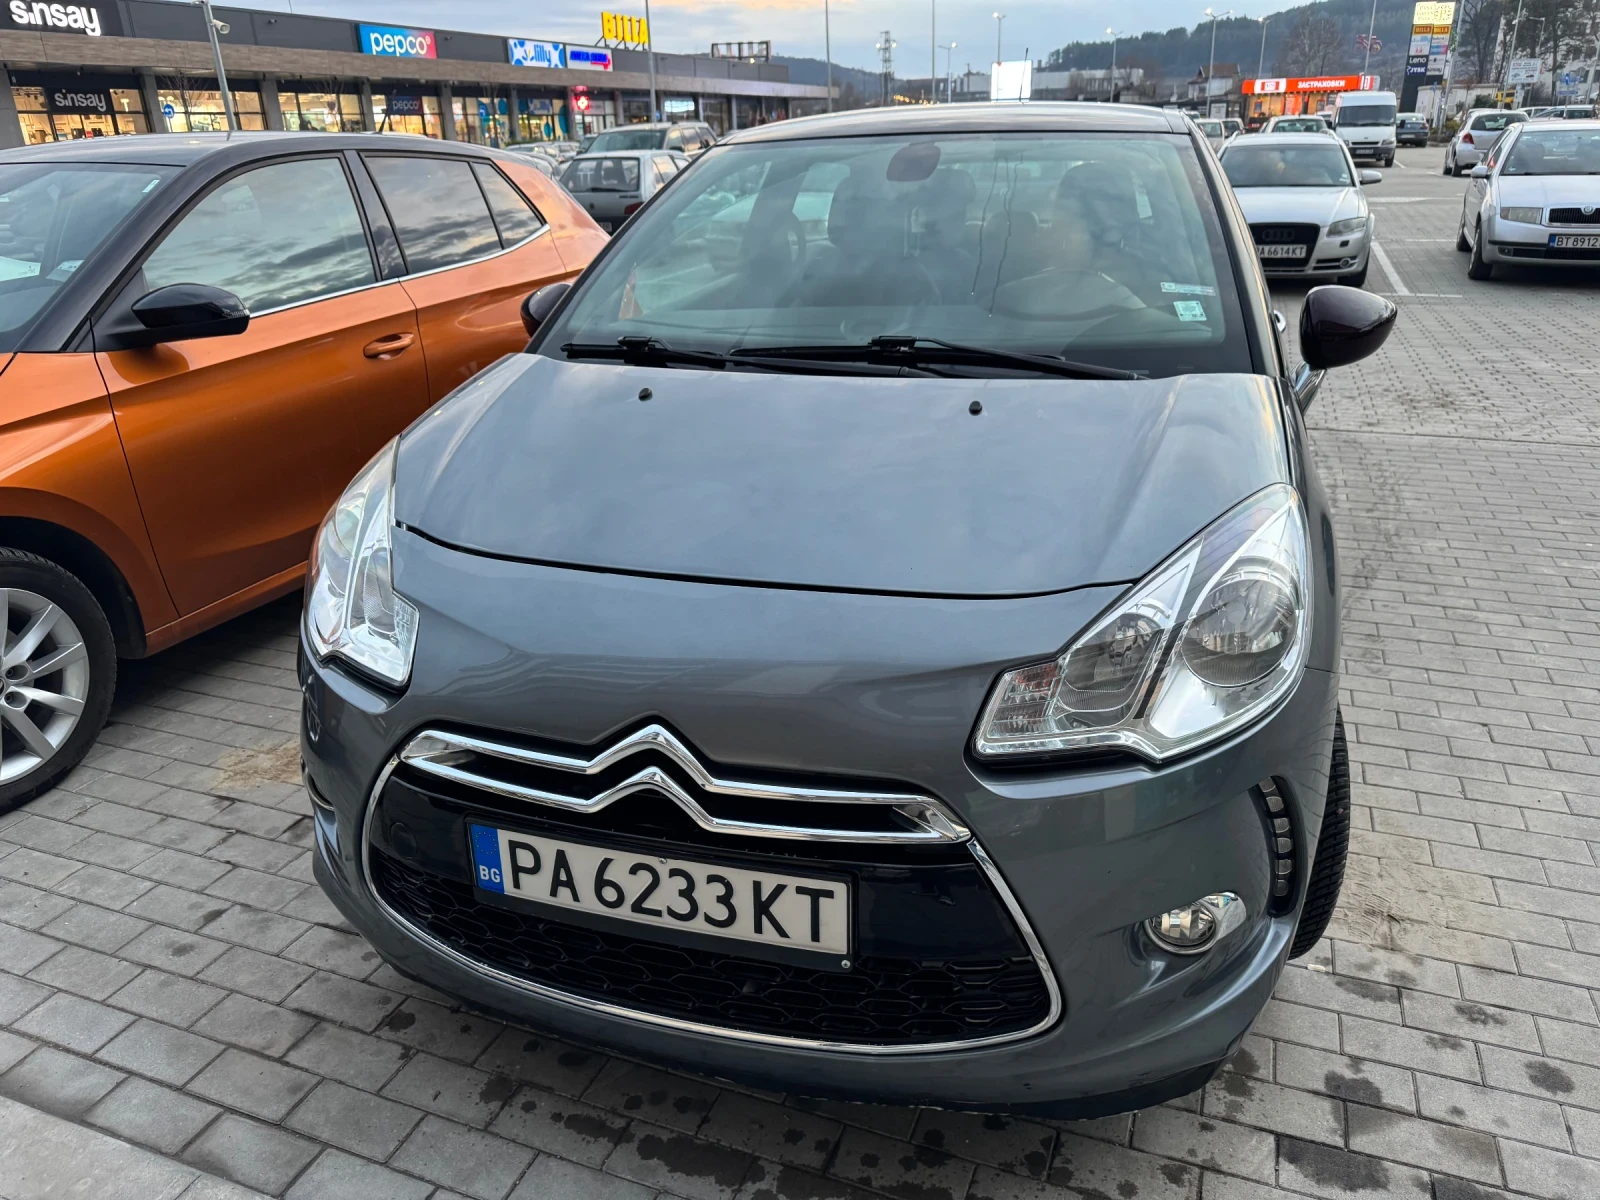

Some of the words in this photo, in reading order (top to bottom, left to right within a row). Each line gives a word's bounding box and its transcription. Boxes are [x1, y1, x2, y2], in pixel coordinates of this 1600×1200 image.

[9, 0, 101, 37] sinsay
[601, 11, 649, 44] BILLA
[533, 43, 551, 67] lilly
[1297, 80, 1346, 89] ЗАСТРАХОВКИ
[54, 88, 107, 112] sinsay
[392, 100, 419, 111] pepco
[1572, 236, 1599, 247] 8912
[479, 864, 501, 883] BG
[507, 839, 580, 903] PA
[594, 857, 737, 929] 6233
[752, 880, 835, 943] KT
